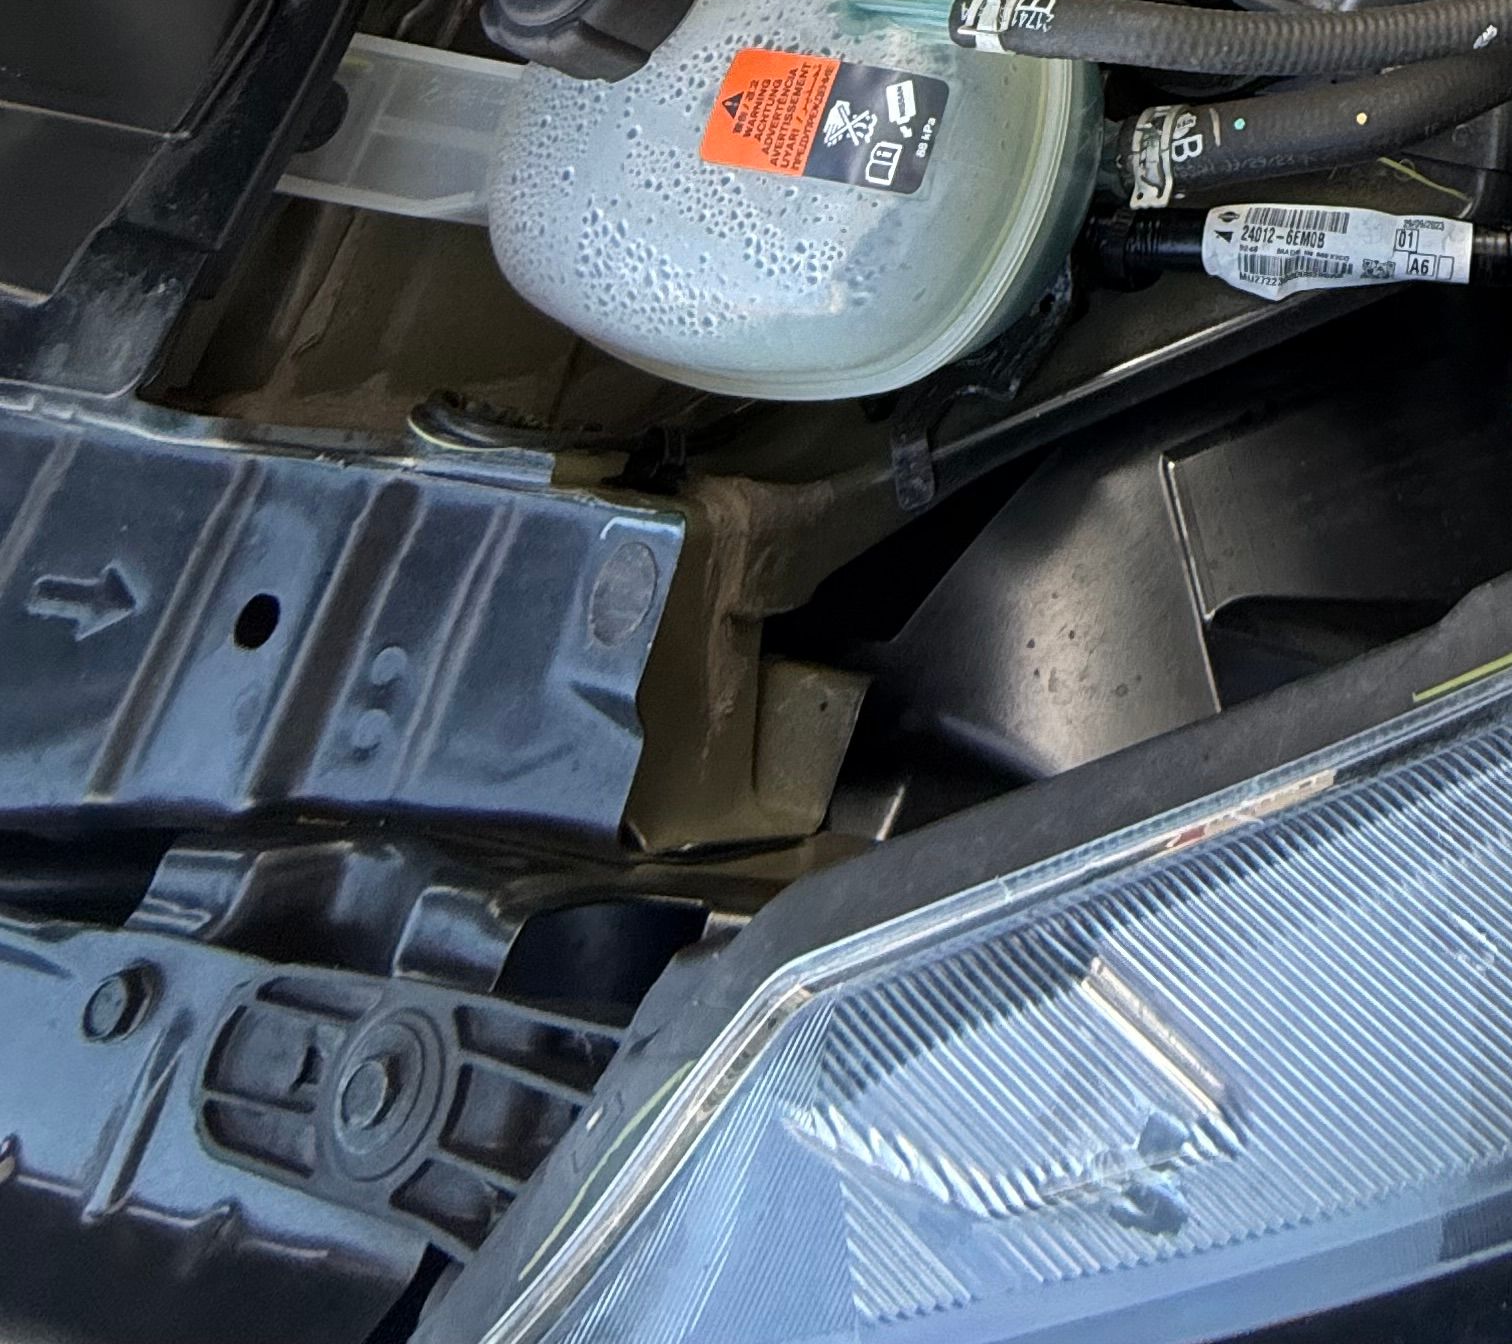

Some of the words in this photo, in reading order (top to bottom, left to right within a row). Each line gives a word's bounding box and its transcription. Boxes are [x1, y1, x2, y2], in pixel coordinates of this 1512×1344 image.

[743, 79, 771, 138] WARNING
[754, 78, 783, 142] ACHTUNG
[770, 62, 812, 166] AVERTISSEMENT
[921, 116, 938, 141] kPa
[780, 127, 800, 169] UYARI
[1171, 133, 1204, 162] B
[1398, 231, 1414, 248] 01
[1410, 257, 1430, 275] A6
